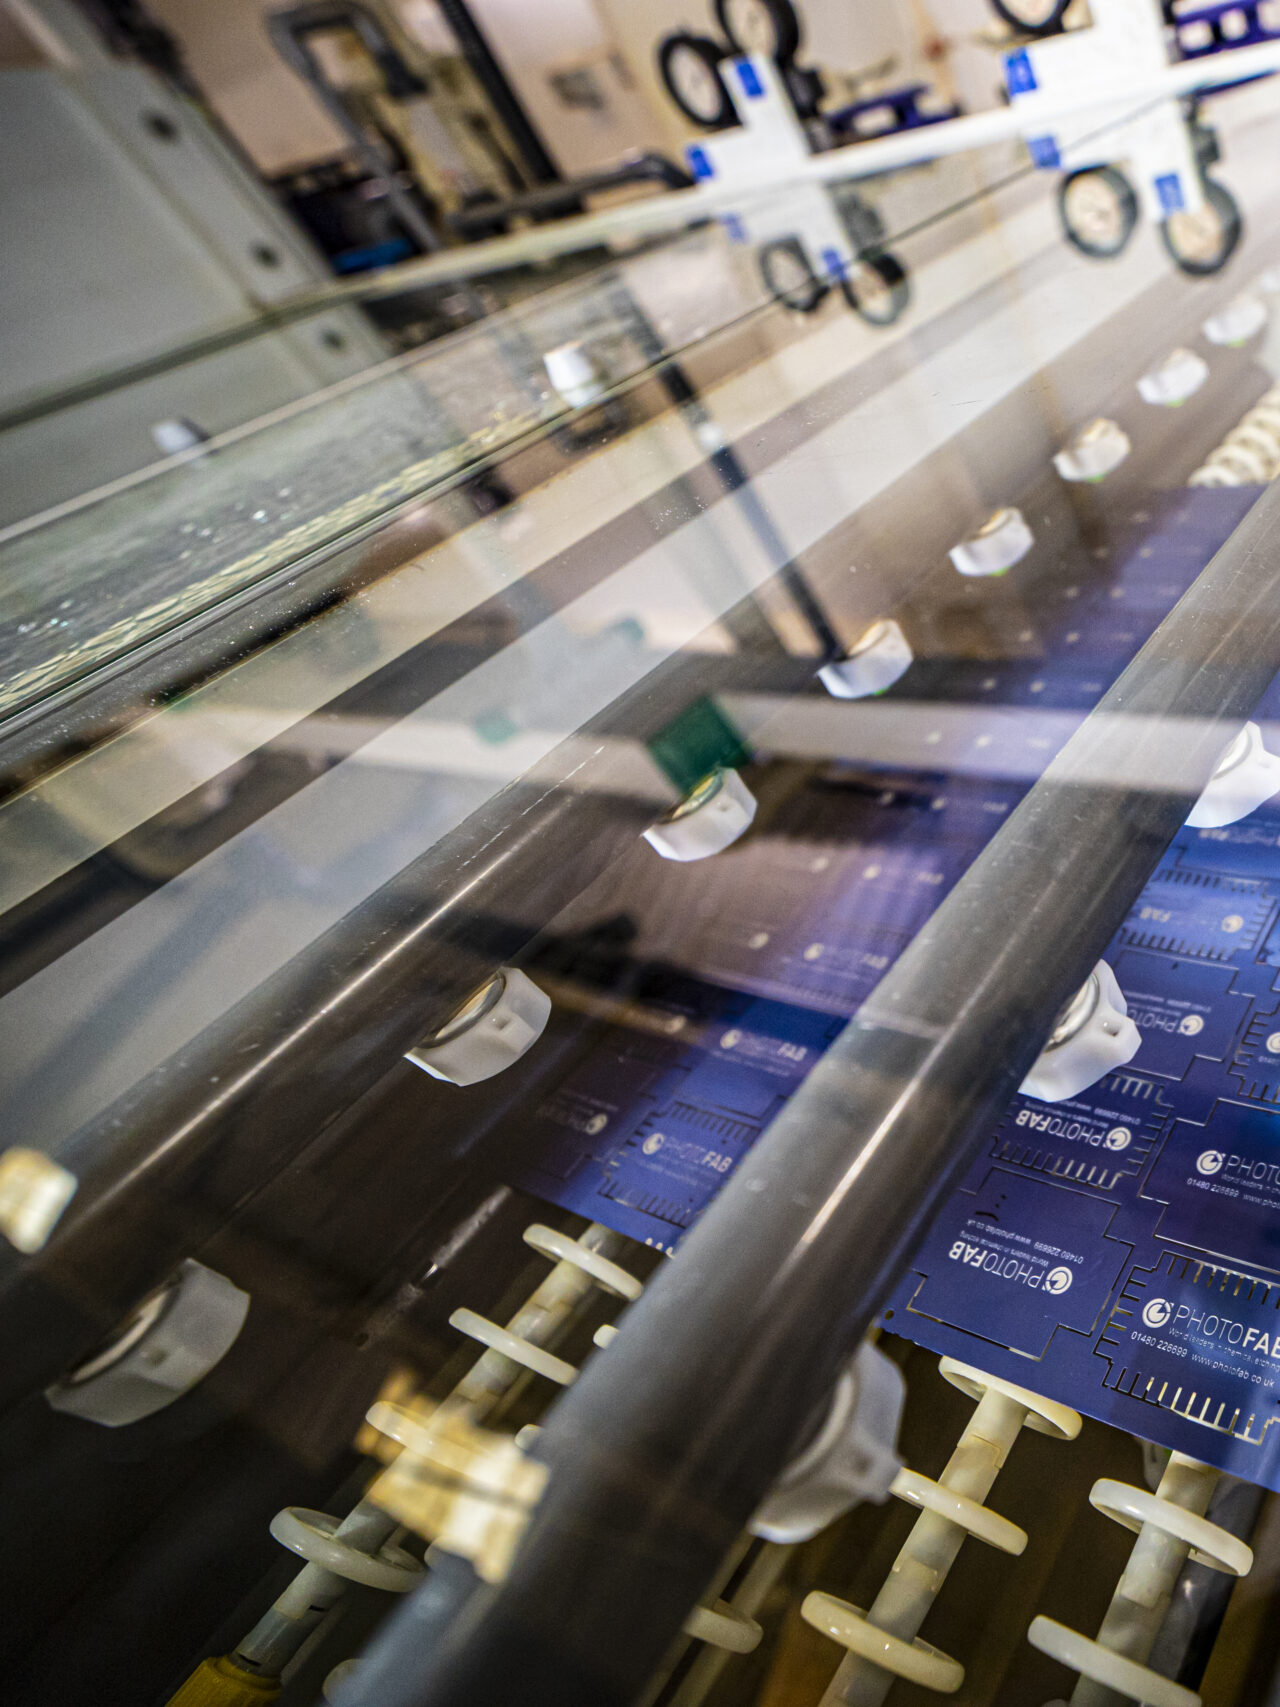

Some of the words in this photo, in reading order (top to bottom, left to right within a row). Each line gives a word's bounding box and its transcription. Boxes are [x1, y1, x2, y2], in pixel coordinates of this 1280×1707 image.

[1125, 1008, 1178, 1033] PHOTO
[1015, 1110, 1104, 1146] PHOTOFAB
[1187, 1178, 1210, 1190] 01480
[967, 1219, 1031, 1244] www.photofab.co.uk
[949, 1241, 1044, 1288] PHOTOFAB
[1061, 1251, 1084, 1264] 01480
[1131, 1331, 1156, 1346] 01480
[1157, 1340, 1187, 1357] 226699
